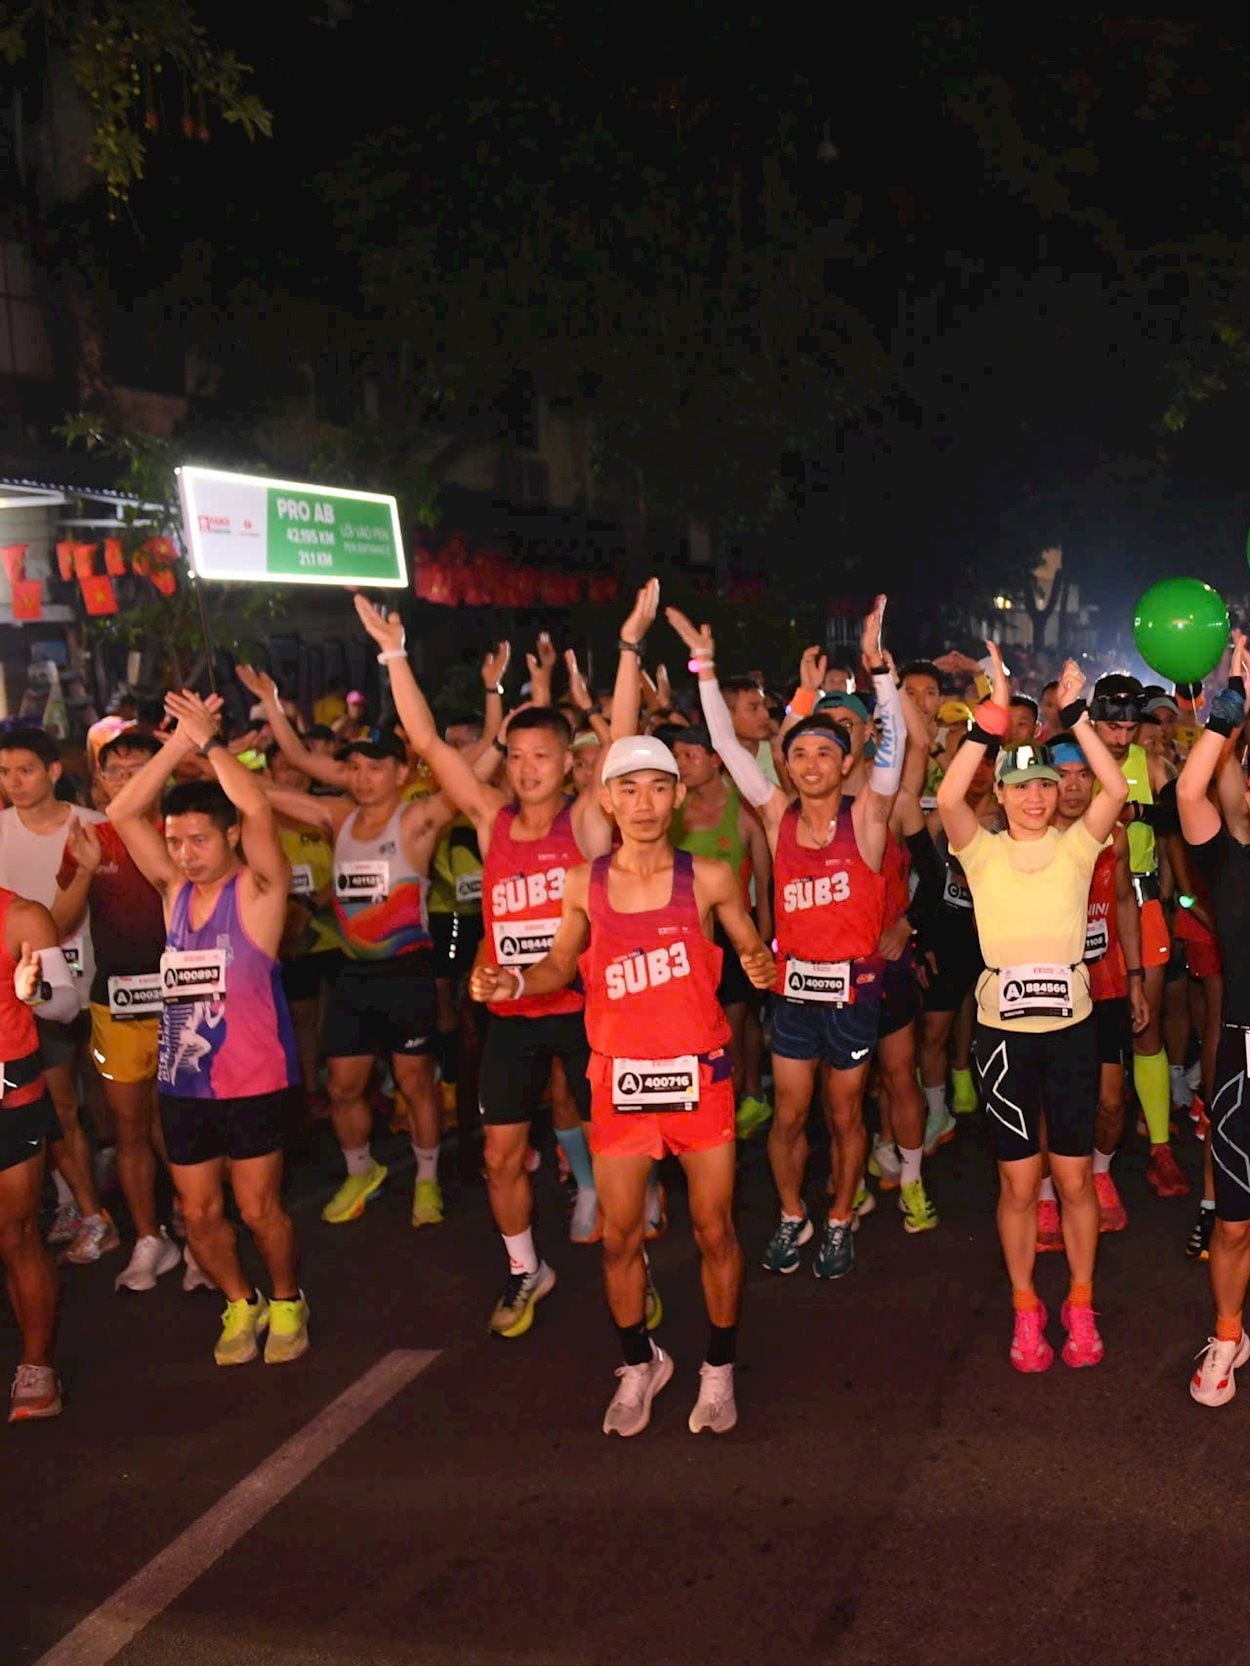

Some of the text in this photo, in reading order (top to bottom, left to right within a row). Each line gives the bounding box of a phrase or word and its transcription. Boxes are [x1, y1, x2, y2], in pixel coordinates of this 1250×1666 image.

[276, 497, 335, 525] PRO AB
[319, 530, 334, 546] KM
[318, 551, 333, 567] KM
[492, 867, 565, 917] SUB3
[784, 871, 850, 913] SUB3
[502, 938, 518, 953] A
[1086, 936, 1104, 947] 1108
[166, 969, 219, 987] A 400893
[605, 941, 691, 1001] SUB3
[791, 974, 843, 989] A 400760
[116, 989, 161, 1005] A 4002
[1005, 982, 1067, 1000] A 884566
[621, 1073, 690, 1091] A 400716
